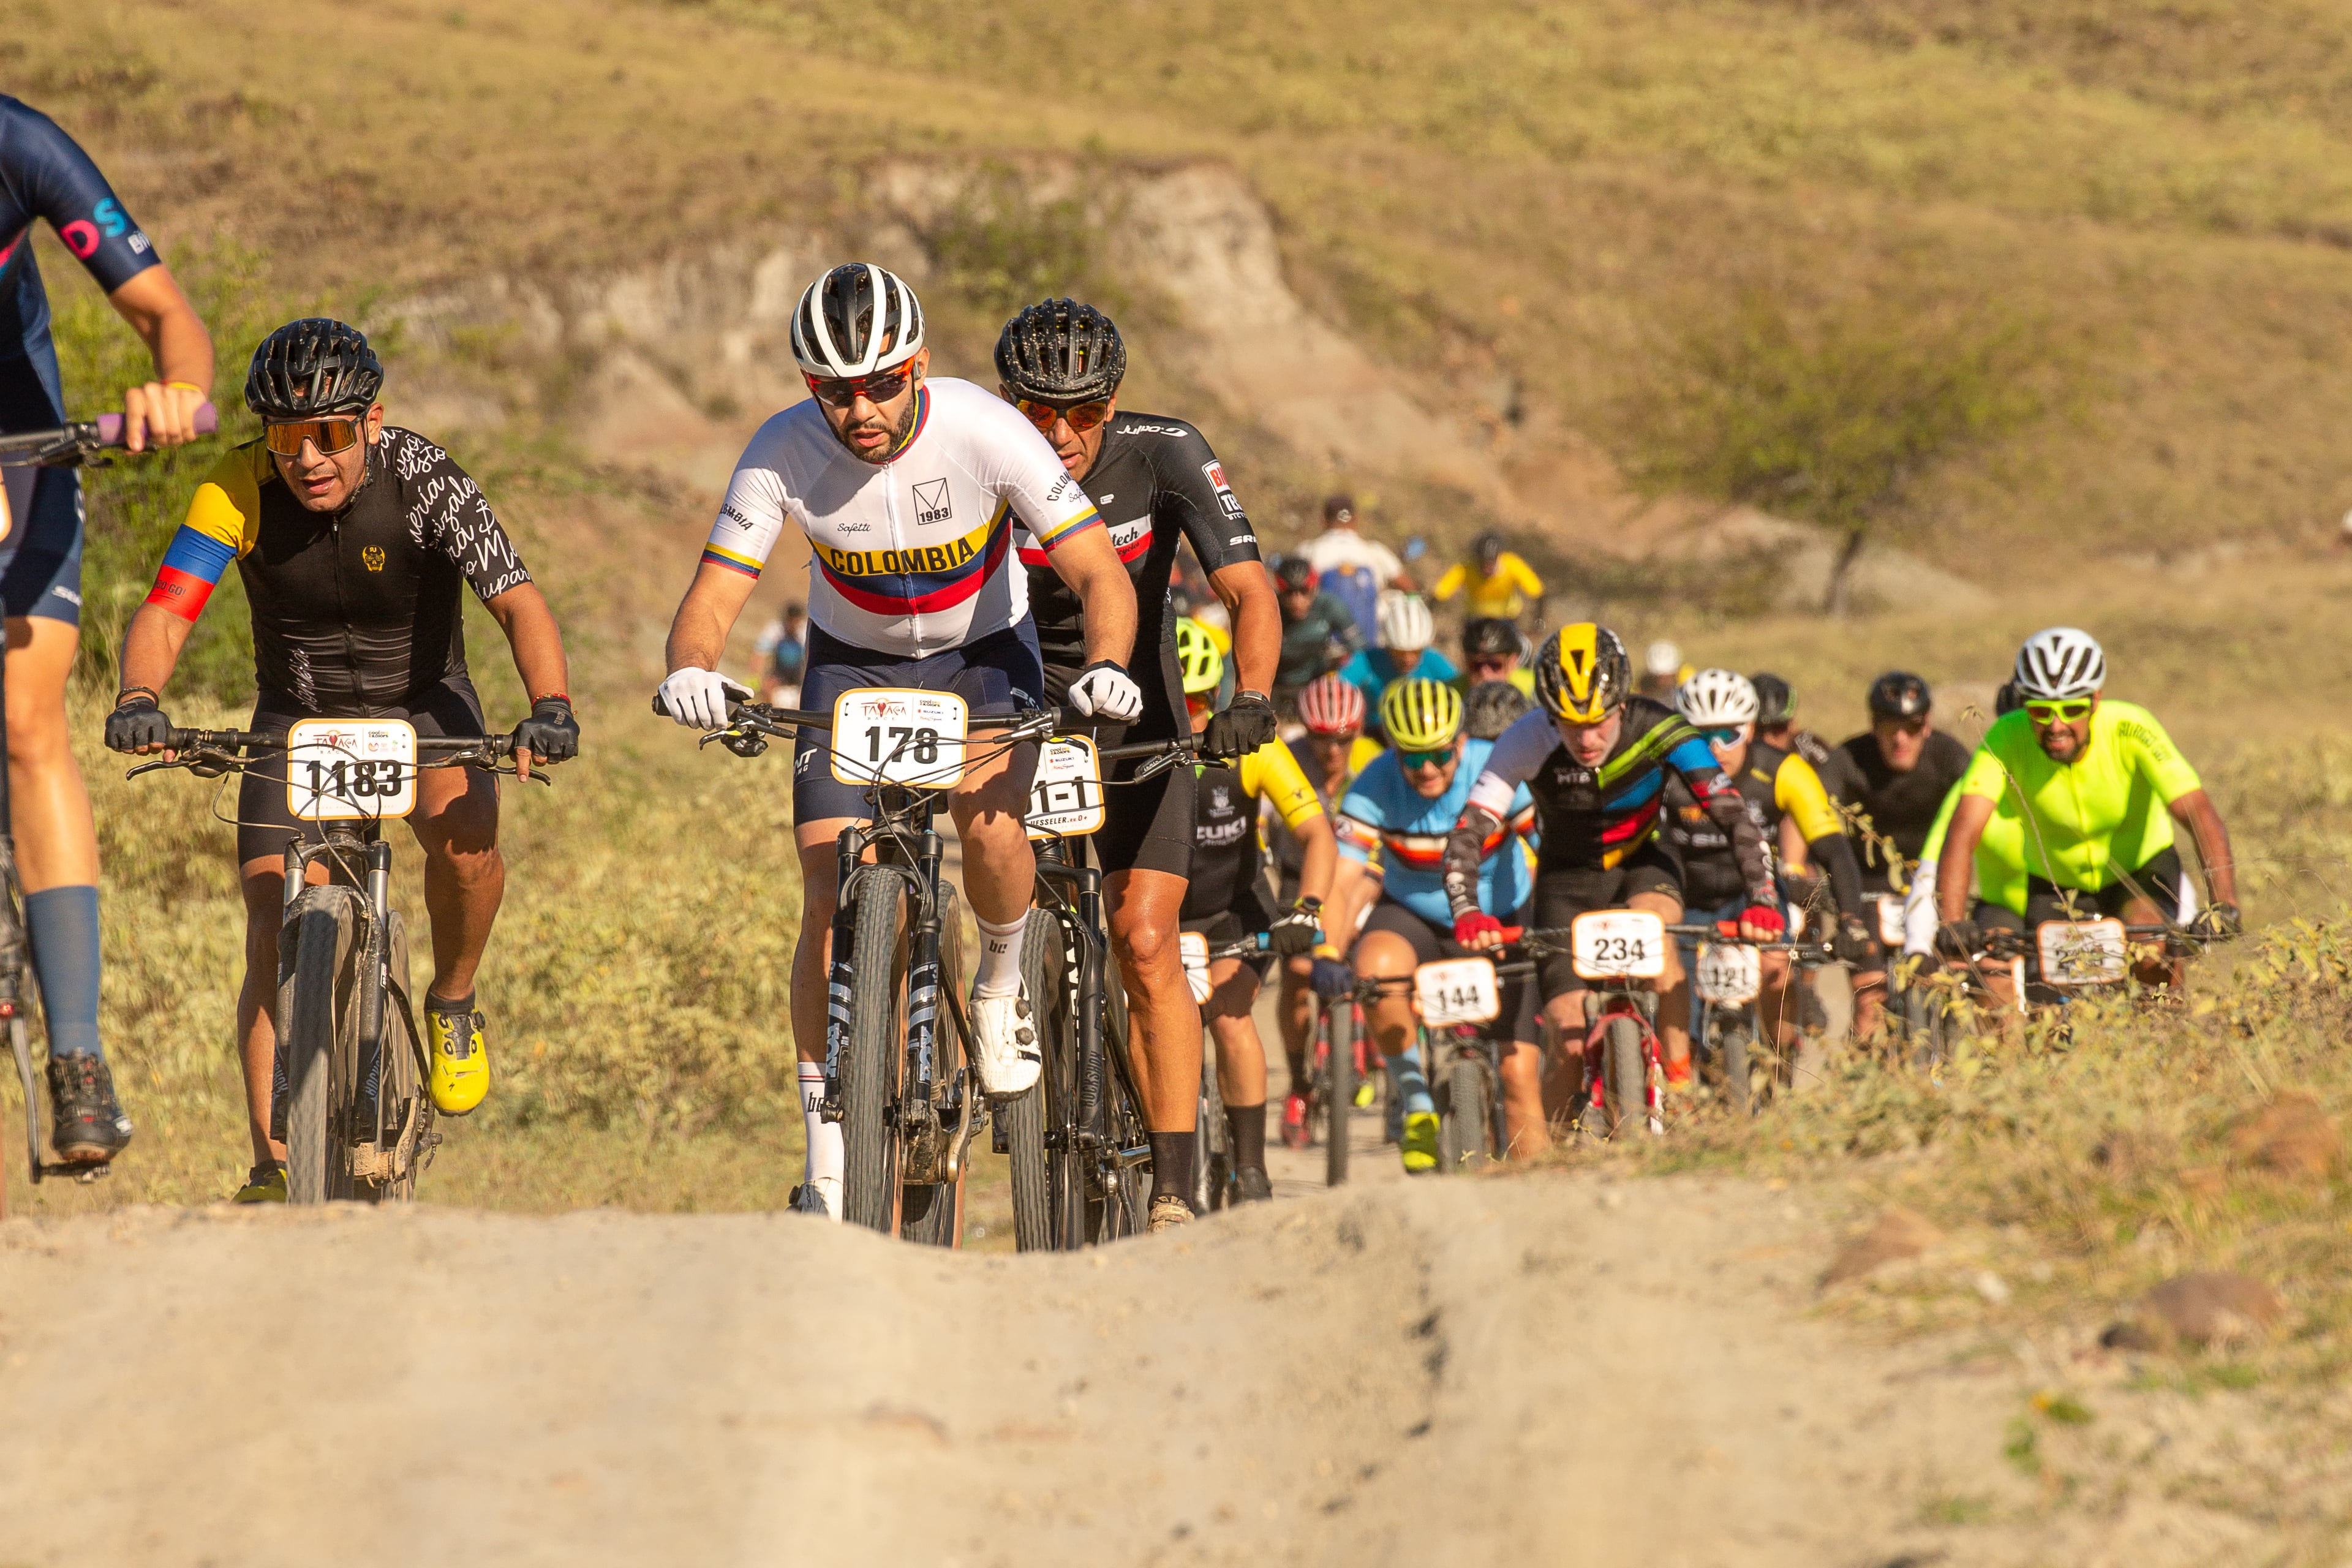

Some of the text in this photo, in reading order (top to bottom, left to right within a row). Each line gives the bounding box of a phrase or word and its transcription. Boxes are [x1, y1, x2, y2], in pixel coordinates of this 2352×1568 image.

[919, 508, 949, 522] 1983
[837, 523, 872, 537] Safetti
[830, 537, 976, 575] COLOMBIA
[865, 726, 938, 764] 178
[306, 760, 402, 797] 1183
[1594, 938, 1646, 960] 234
[1437, 984, 1479, 1012] 144
